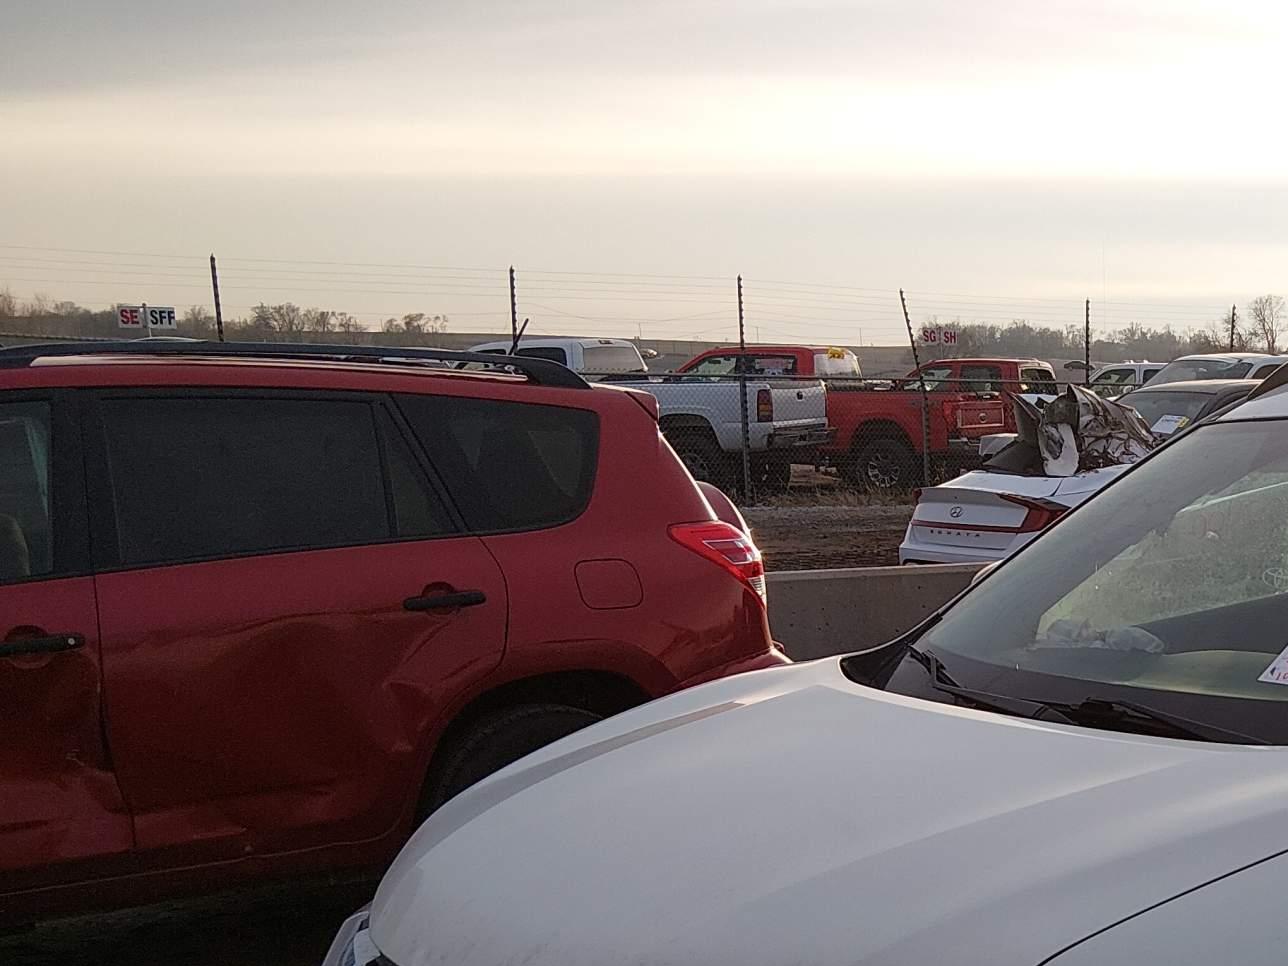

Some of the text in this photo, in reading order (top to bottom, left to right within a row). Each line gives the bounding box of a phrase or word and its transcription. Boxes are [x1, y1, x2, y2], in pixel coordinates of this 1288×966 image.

[120, 308, 140, 325] SE
[150, 309, 176, 326] SFF
[922, 329, 937, 342] SG
[943, 331, 957, 344] SH
